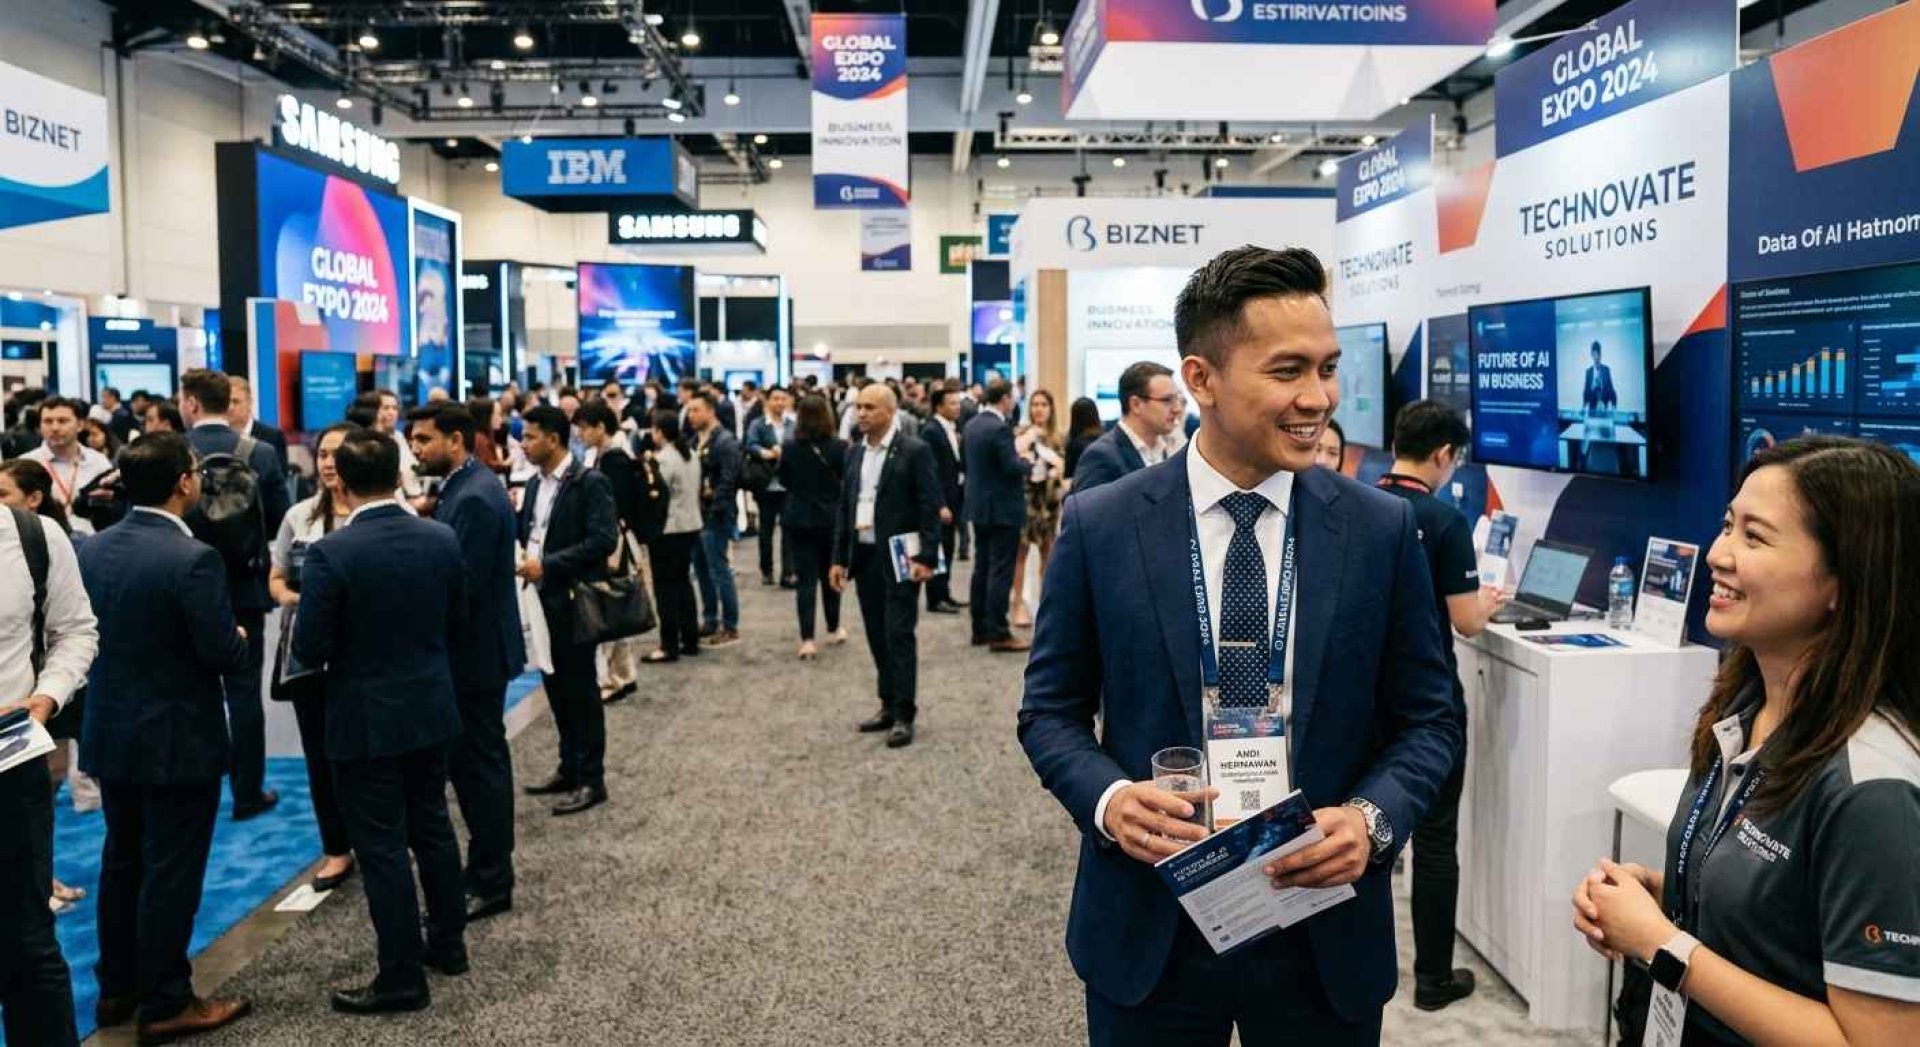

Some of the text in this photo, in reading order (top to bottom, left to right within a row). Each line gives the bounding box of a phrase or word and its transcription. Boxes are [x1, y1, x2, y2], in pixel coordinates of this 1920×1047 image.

[822, 35, 897, 51] GLOBAL
[834, 51, 885, 66] EXPO
[1552, 18, 1643, 85] GLOBAL
[837, 67, 882, 82] 2024
[1541, 50, 1658, 128] EXPO 2024
[5, 109, 82, 153] BIZNET
[280, 94, 400, 184] SAMSUNG
[547, 150, 627, 184] IBM
[1519, 160, 1696, 236] TECHNOVATE
[618, 214, 740, 239] SAMSUNG
[1106, 224, 1205, 244] BIZNET
[1544, 218, 1658, 260] SOLUTIONS
[1758, 234, 1797, 255] Data
[1801, 226, 1823, 248] Of
[1825, 223, 1842, 245] AI
[311, 246, 379, 289] GLOBAL
[1478, 350, 1550, 369] FUTURE OF AI
[1479, 372, 1490, 389] IN
[1491, 373, 1544, 390] BUSINESS
[1236, 750, 1260, 758] ANDI
